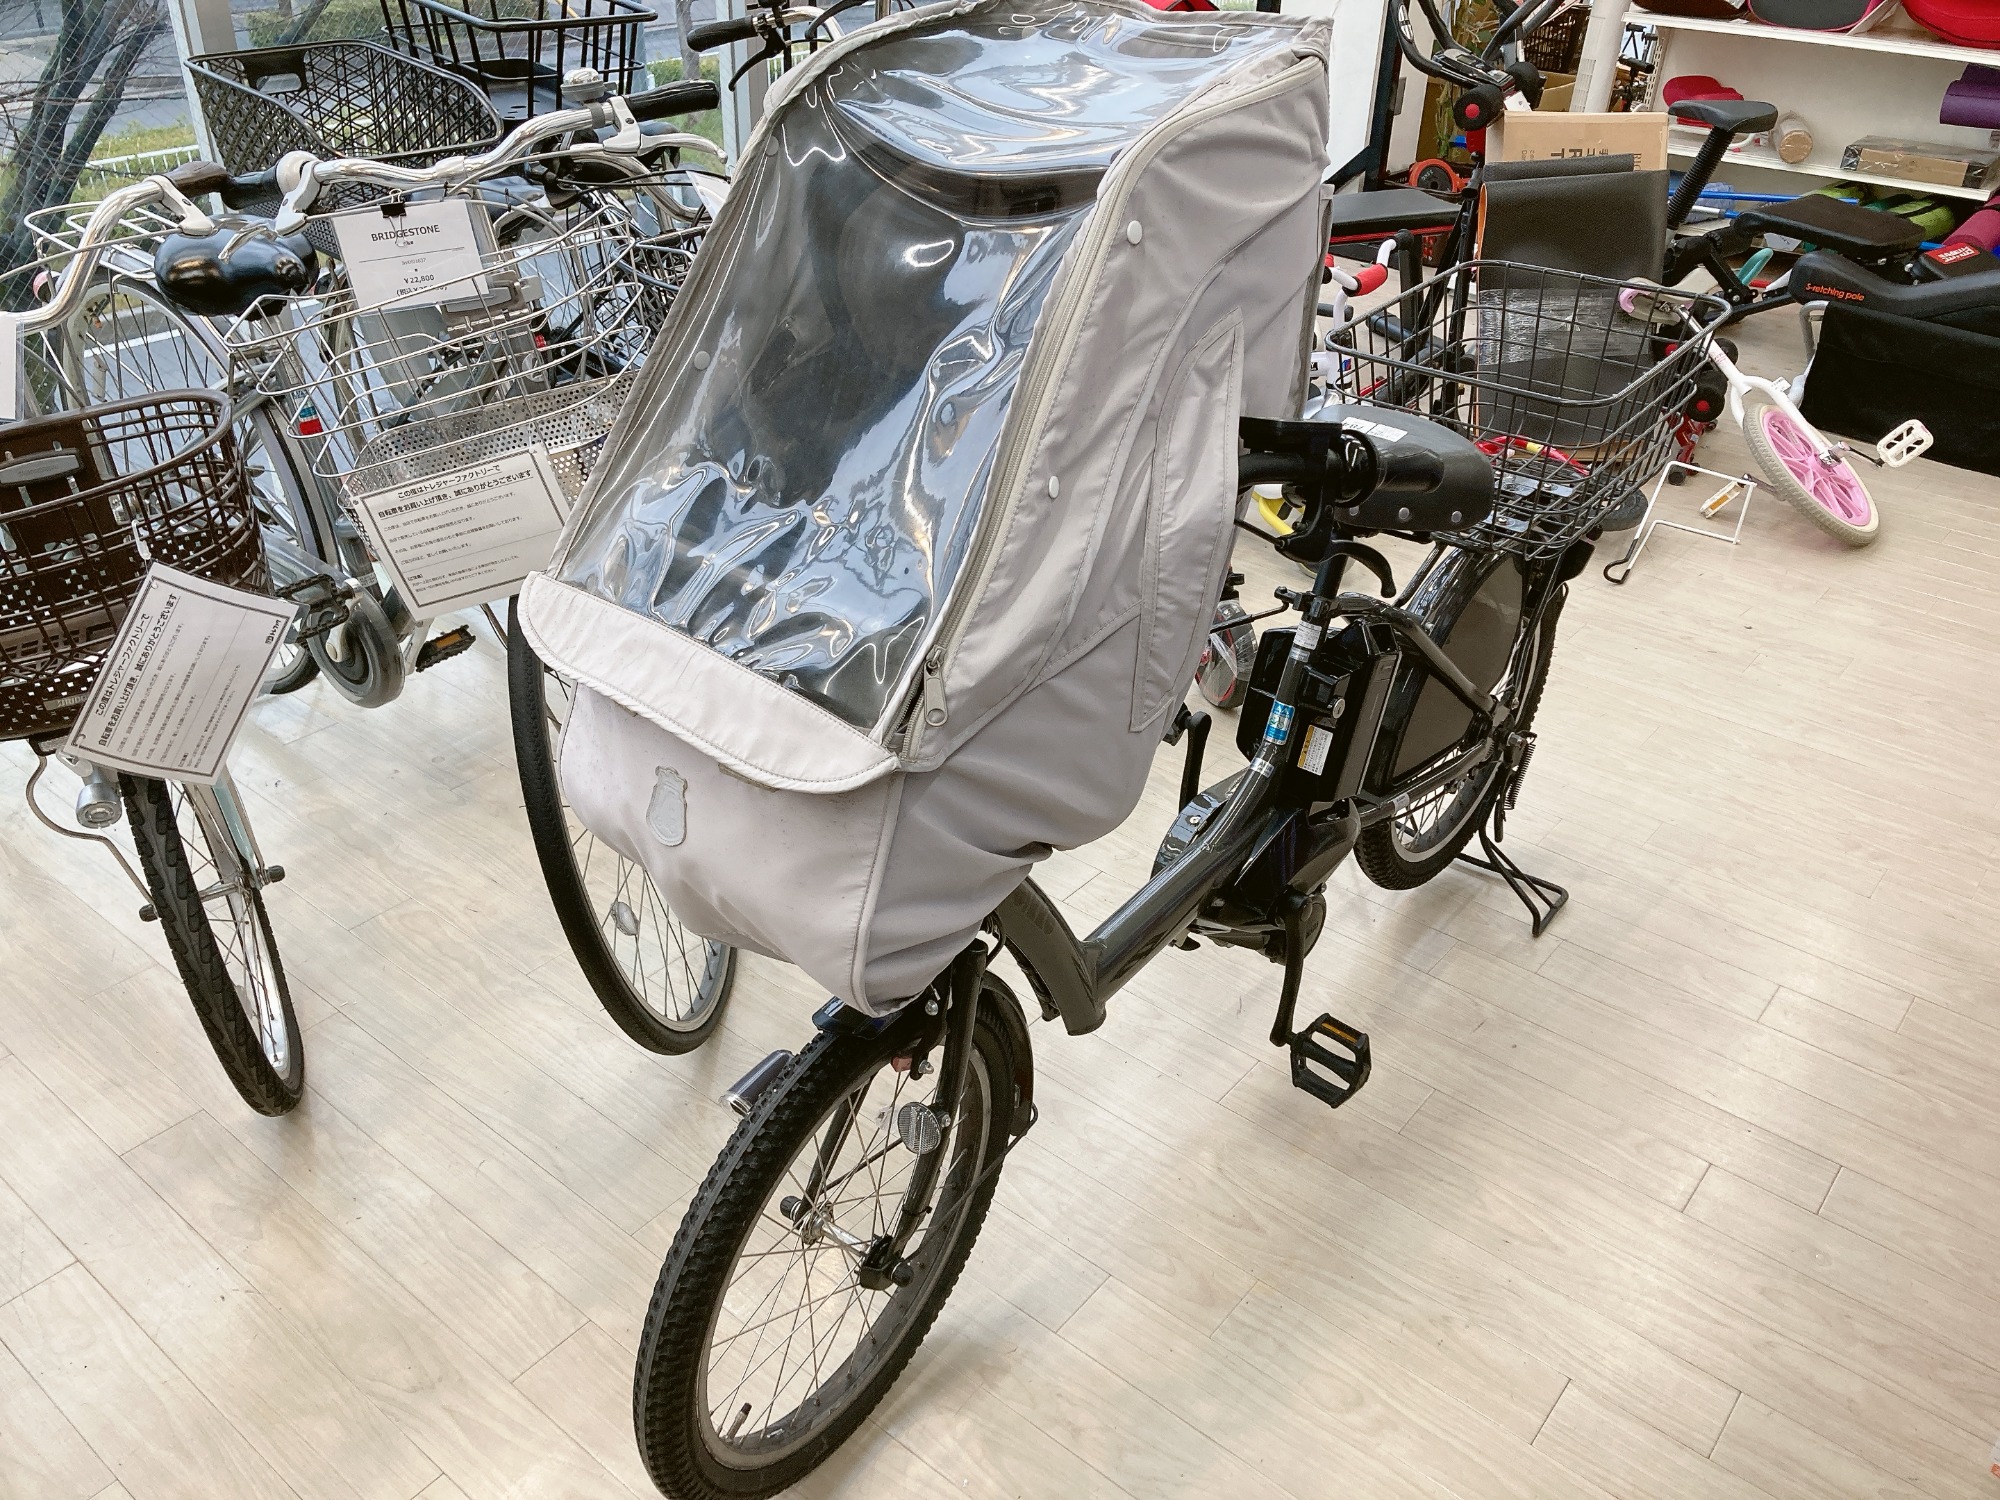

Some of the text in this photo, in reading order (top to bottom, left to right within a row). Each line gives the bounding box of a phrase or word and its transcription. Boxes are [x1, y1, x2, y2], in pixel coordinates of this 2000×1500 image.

[371, 225, 440, 242] BRIDGESTONE
[403, 274, 434, 284] ¥22,800
[1844, 292, 1864, 301] pole
[398, 464, 500, 499] この度はトレジャーファクトリーで
[96, 613, 150, 716] この度はトレジャーファクトリーで
[97, 593, 177, 747] 自転車をお買い上げ頂き、誠にありがとうございます
